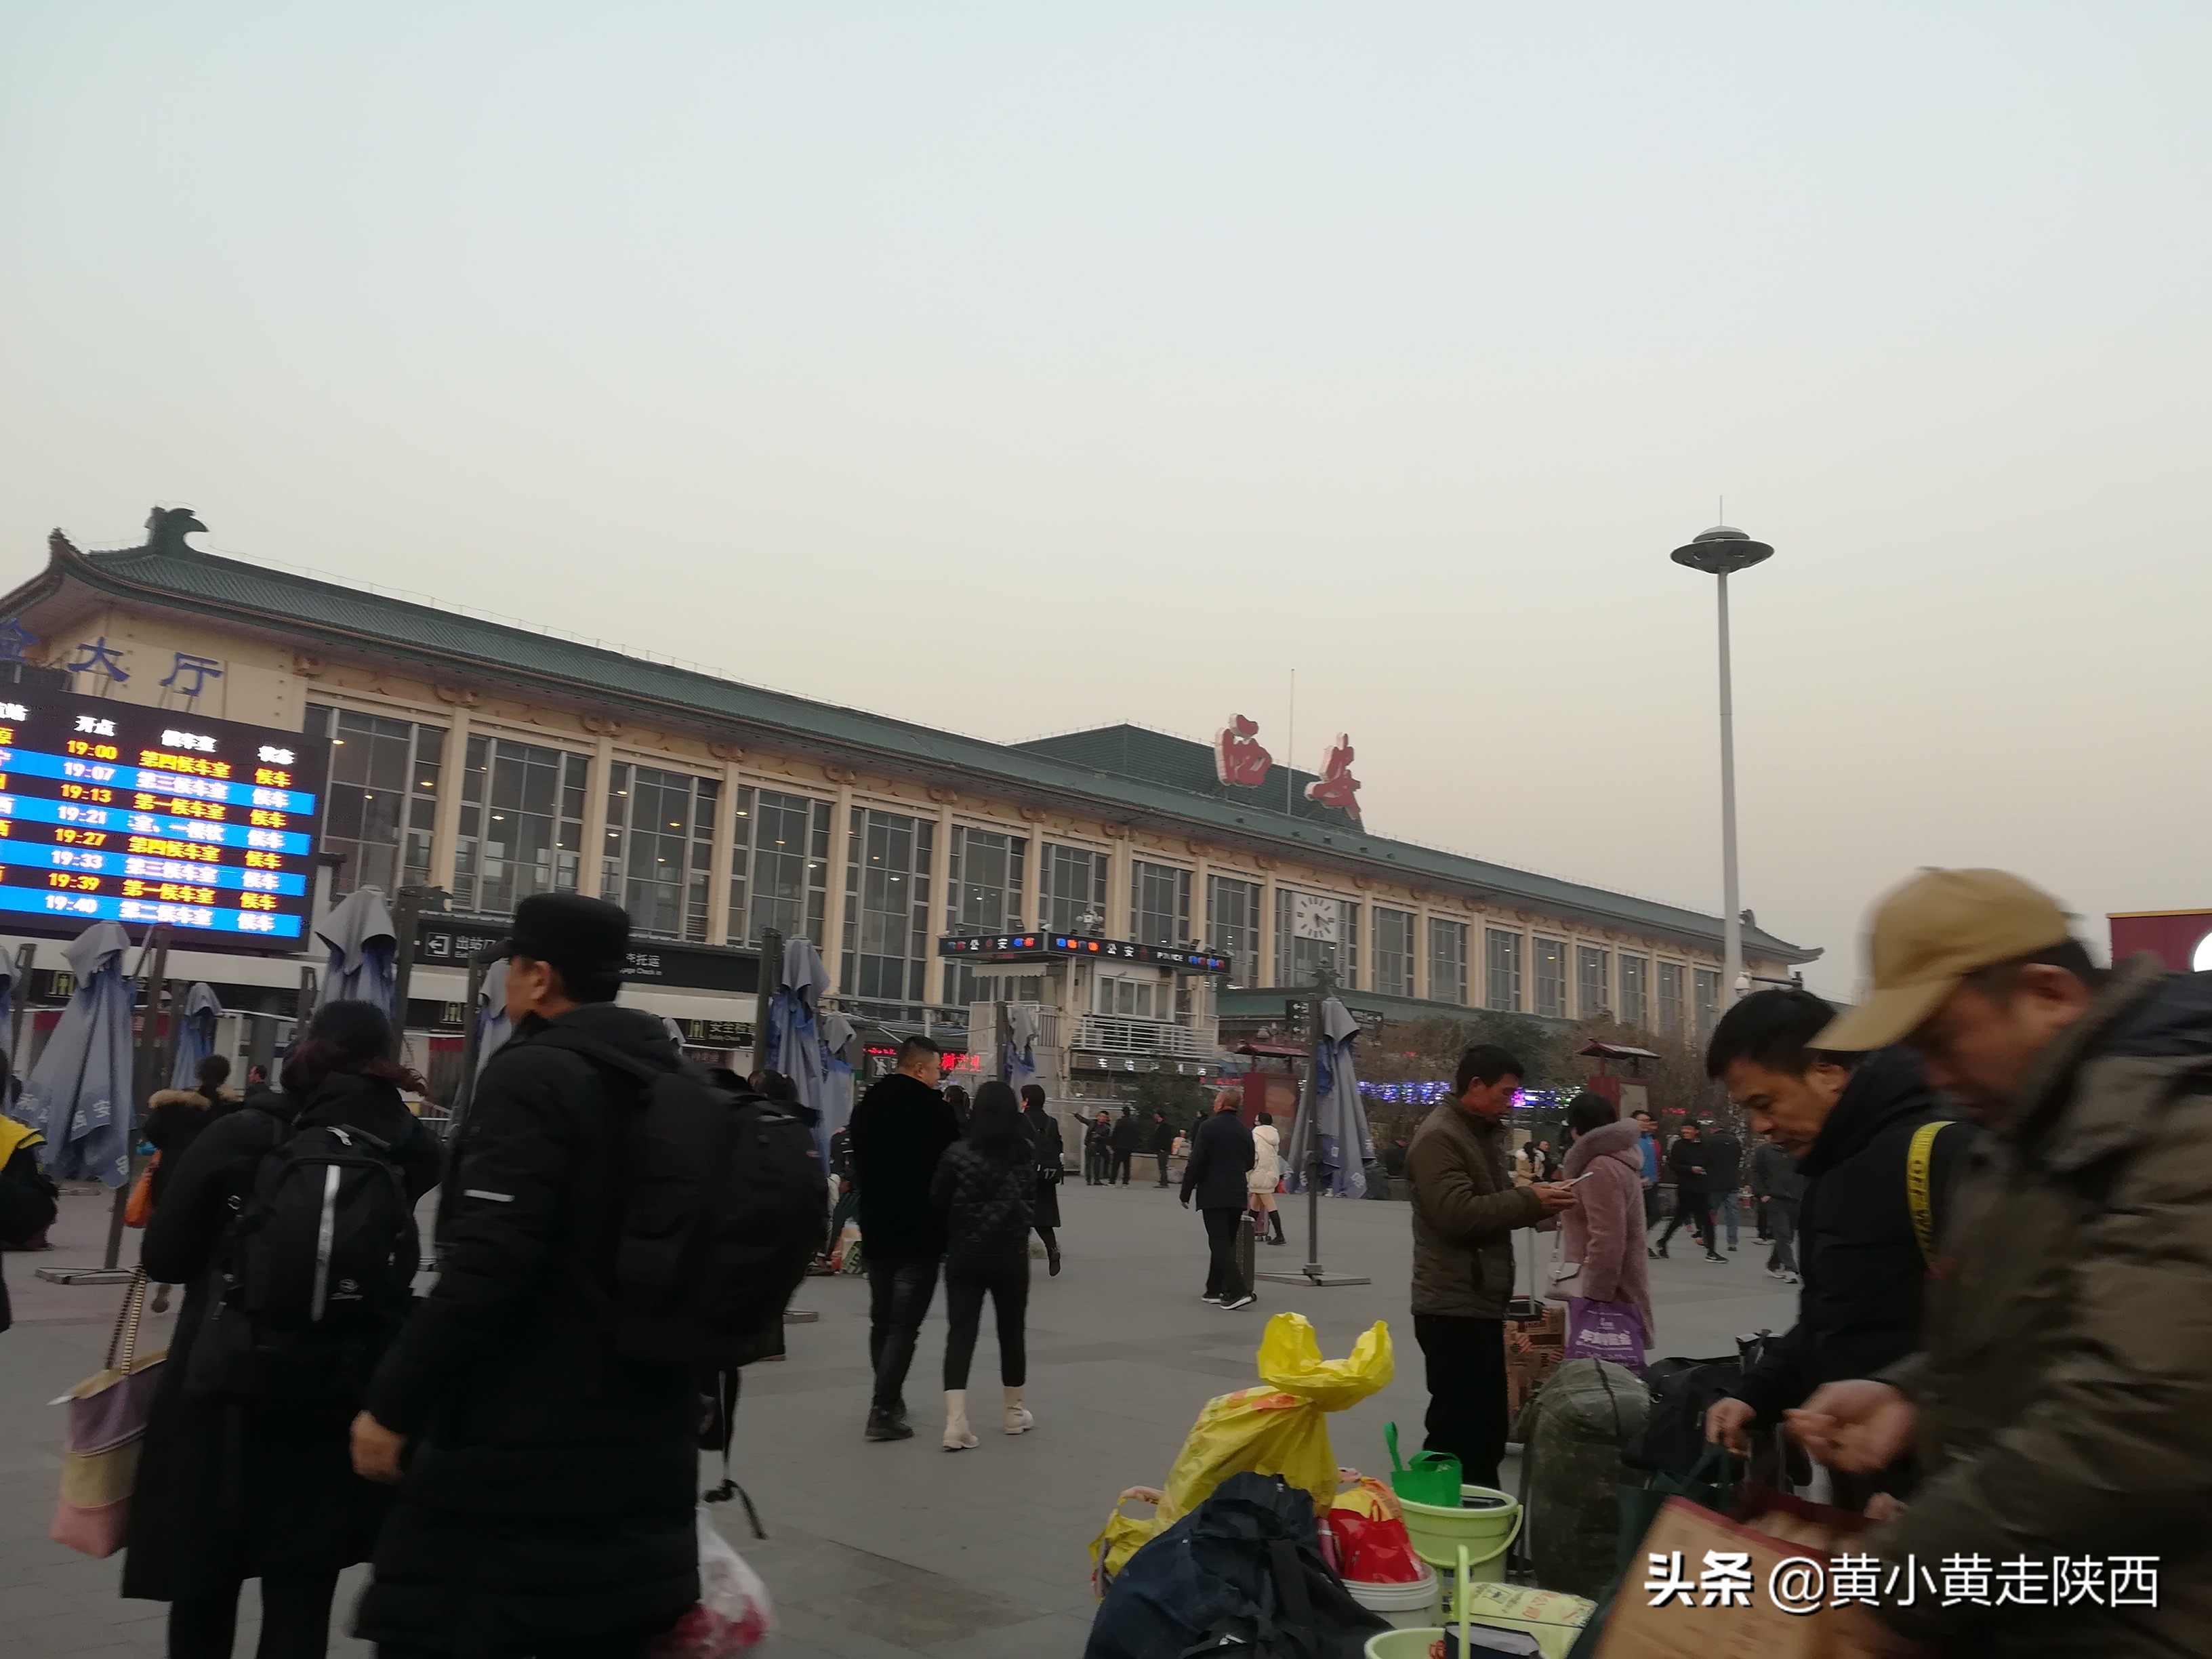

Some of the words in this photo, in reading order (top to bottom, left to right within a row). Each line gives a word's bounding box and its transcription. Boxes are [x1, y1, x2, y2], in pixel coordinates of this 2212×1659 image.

[161, 729, 218, 753] 候车室
[67, 740, 118, 760] 19:00
[140, 750, 231, 779] 第四候车室
[255, 769, 291, 787] 候车
[64, 762, 115, 781] 19:07
[252, 789, 289, 808] 候车
[61, 784, 112, 803] 19:13
[134, 793, 226, 821] 第一候车室
[250, 809, 287, 827] 候车
[58, 806, 107, 825] 19:21
[247, 830, 284, 848] 候车
[55, 828, 106, 846] 19:27
[127, 836, 221, 862] 第四候车室
[245, 851, 282, 869] 候车
[52, 851, 102, 869] 19:33
[243, 871, 279, 889] 候车
[49, 873, 100, 891] 19:39
[121, 880, 216, 905] 第一候车室
[240, 892, 277, 911] 候车
[45, 895, 98, 914] 19:40
[237, 913, 274, 932] 候车
[1157, 951, 1184, 962] POLICE
[1044, 1168, 1057, 1180] 17
